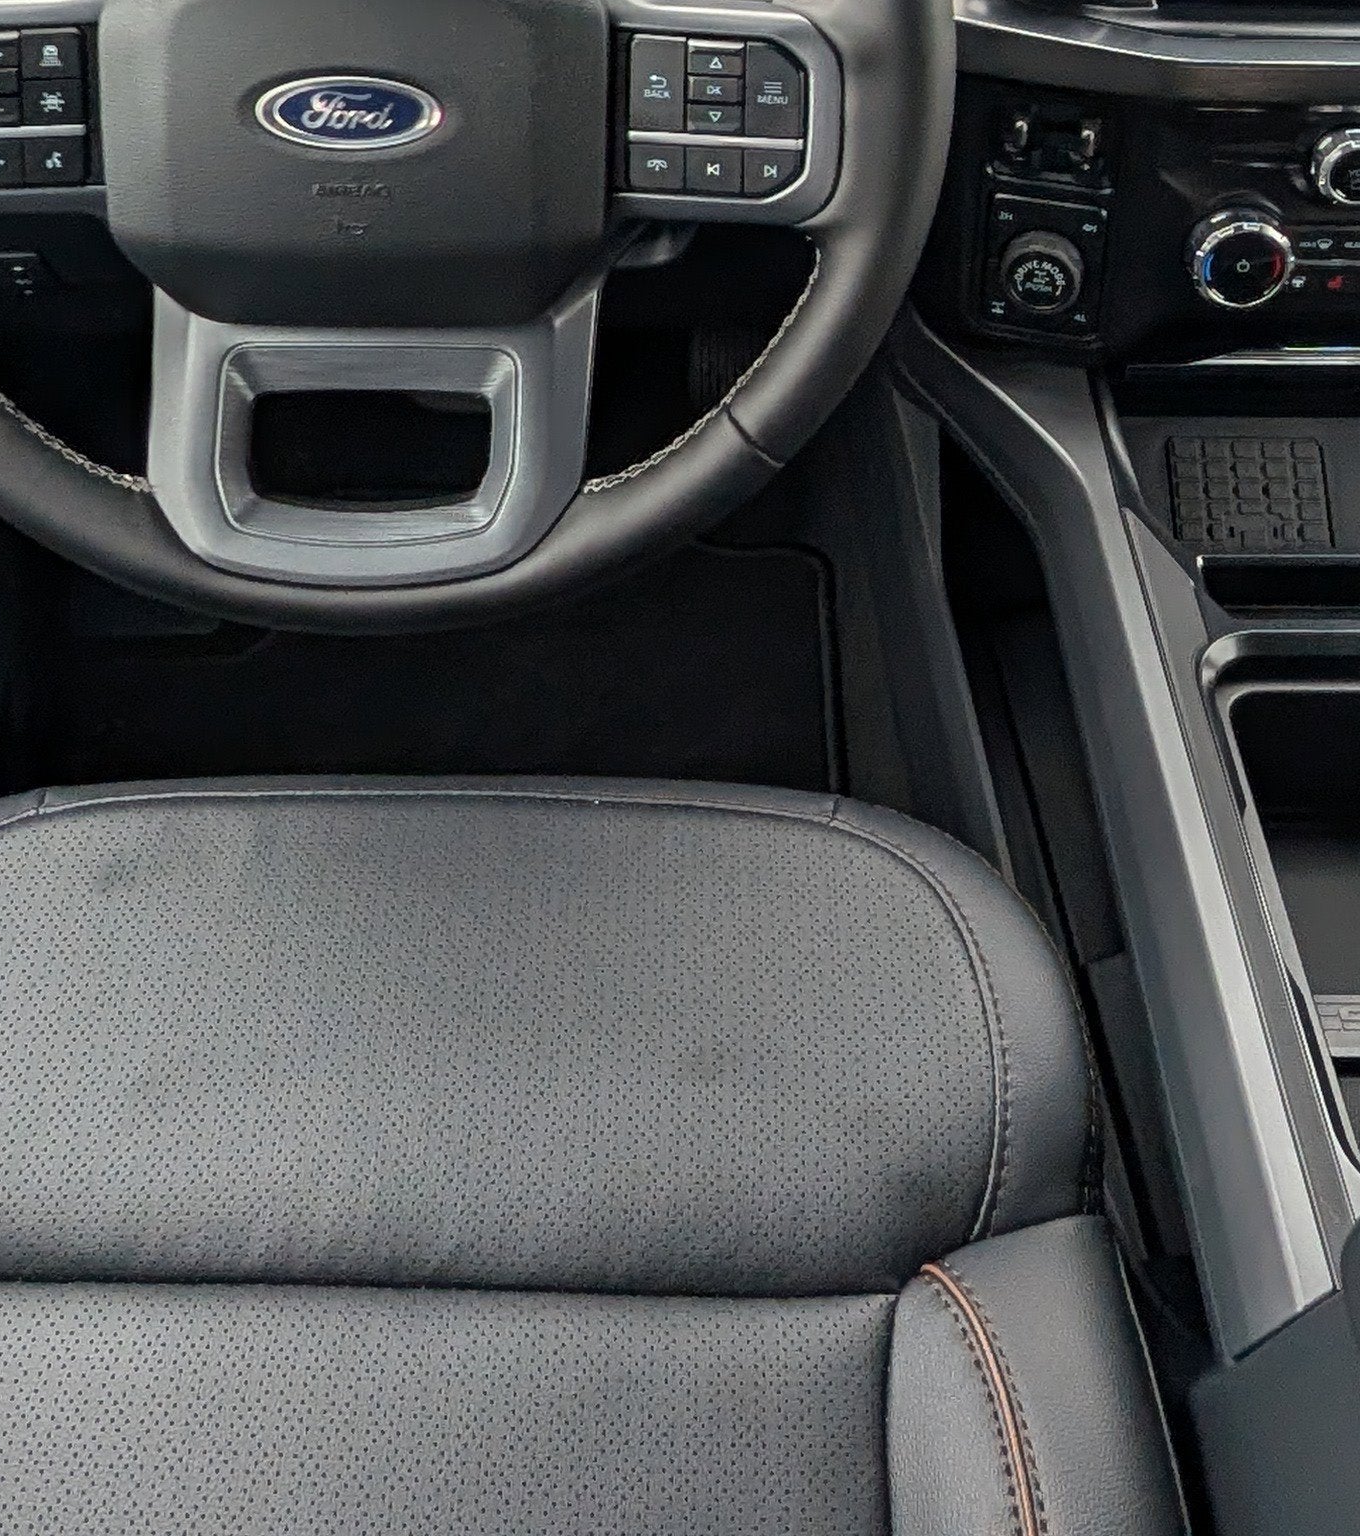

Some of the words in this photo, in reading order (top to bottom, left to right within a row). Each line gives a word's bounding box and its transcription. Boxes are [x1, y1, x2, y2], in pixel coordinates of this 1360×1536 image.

[643, 89, 672, 100] BACK
[706, 85, 723, 96] OK
[756, 94, 789, 105] MENU
[300, 90, 394, 130] Ford
[1013, 259, 1040, 282] DRIVE
[1040, 260, 1067, 286] MODE
